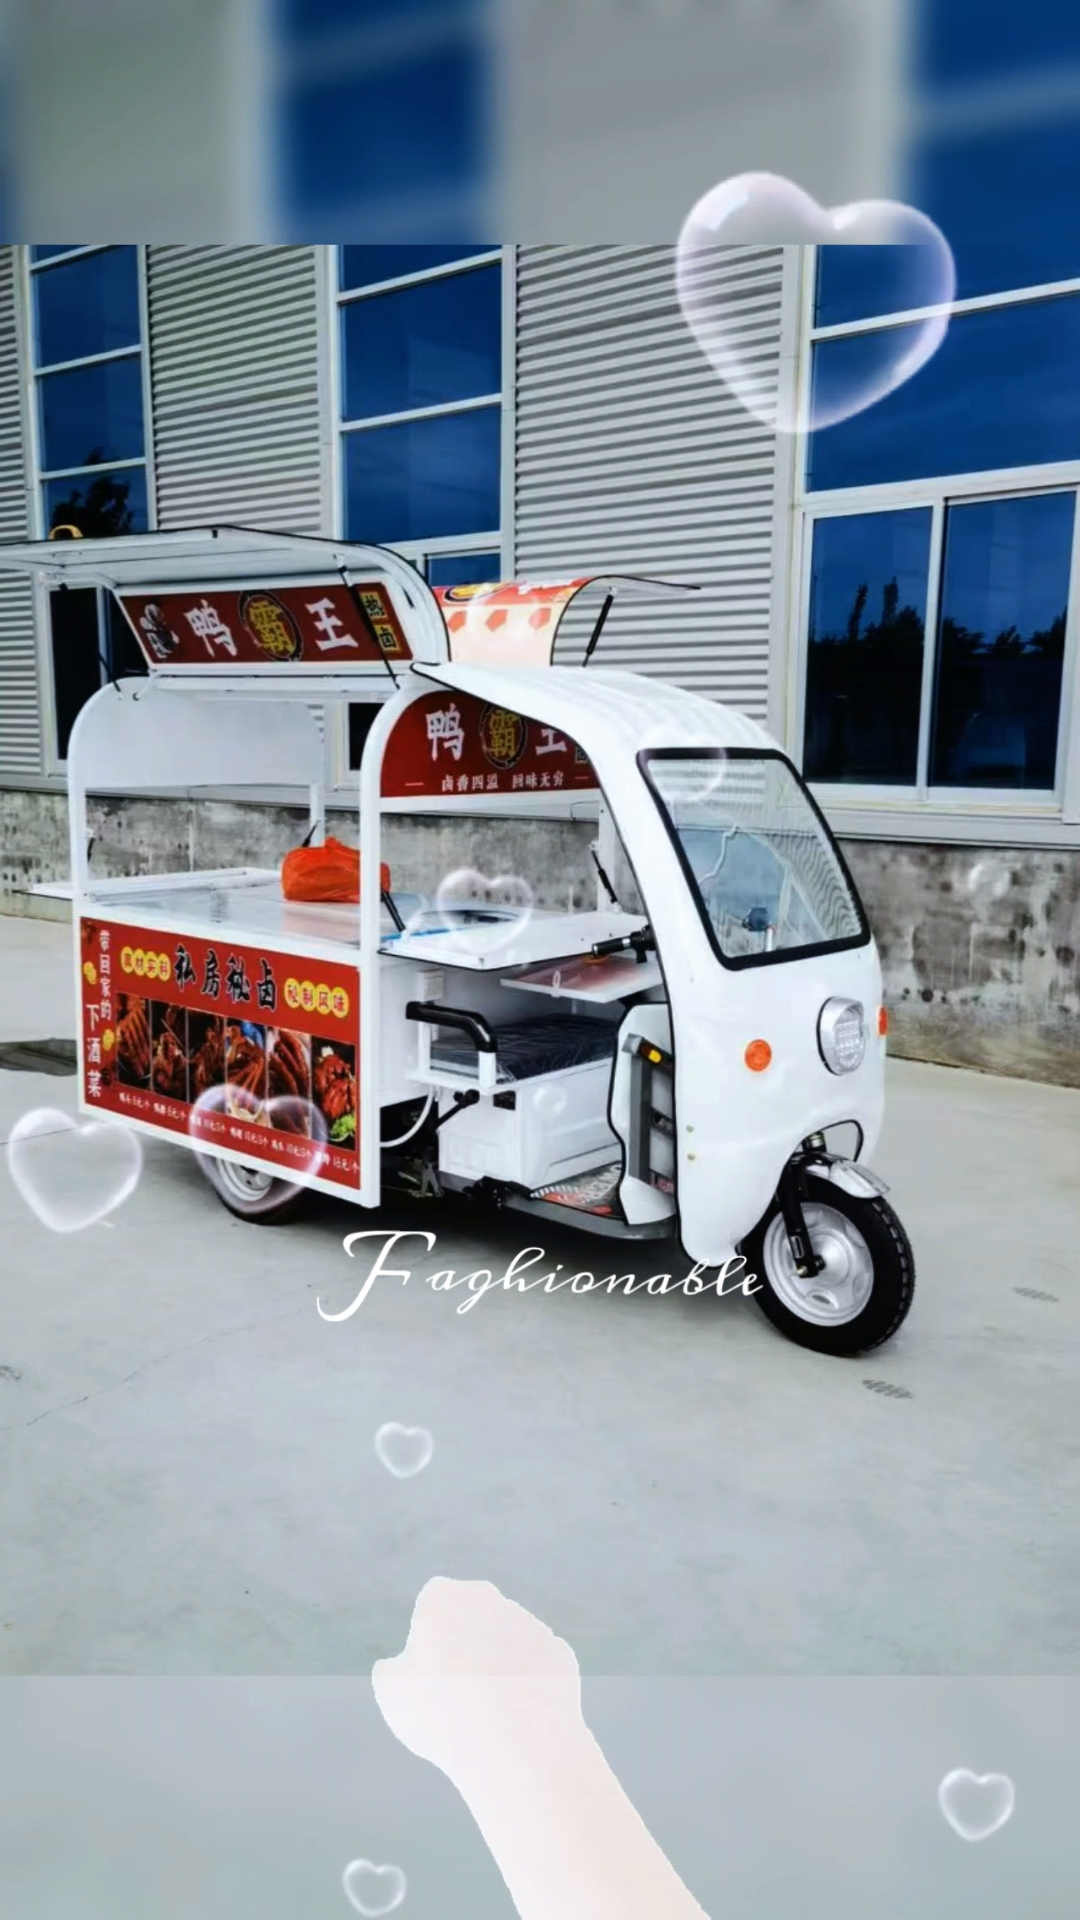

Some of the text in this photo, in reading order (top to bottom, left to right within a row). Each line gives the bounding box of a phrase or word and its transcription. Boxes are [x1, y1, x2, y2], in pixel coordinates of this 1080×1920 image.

[183, 597, 358, 657] 鸭霸王
[442, 770, 564, 792] 卤香四溢 回味无穷
[174, 943, 278, 1012] 私房秘卤
[85, 1004, 102, 1097] 下酒菜
